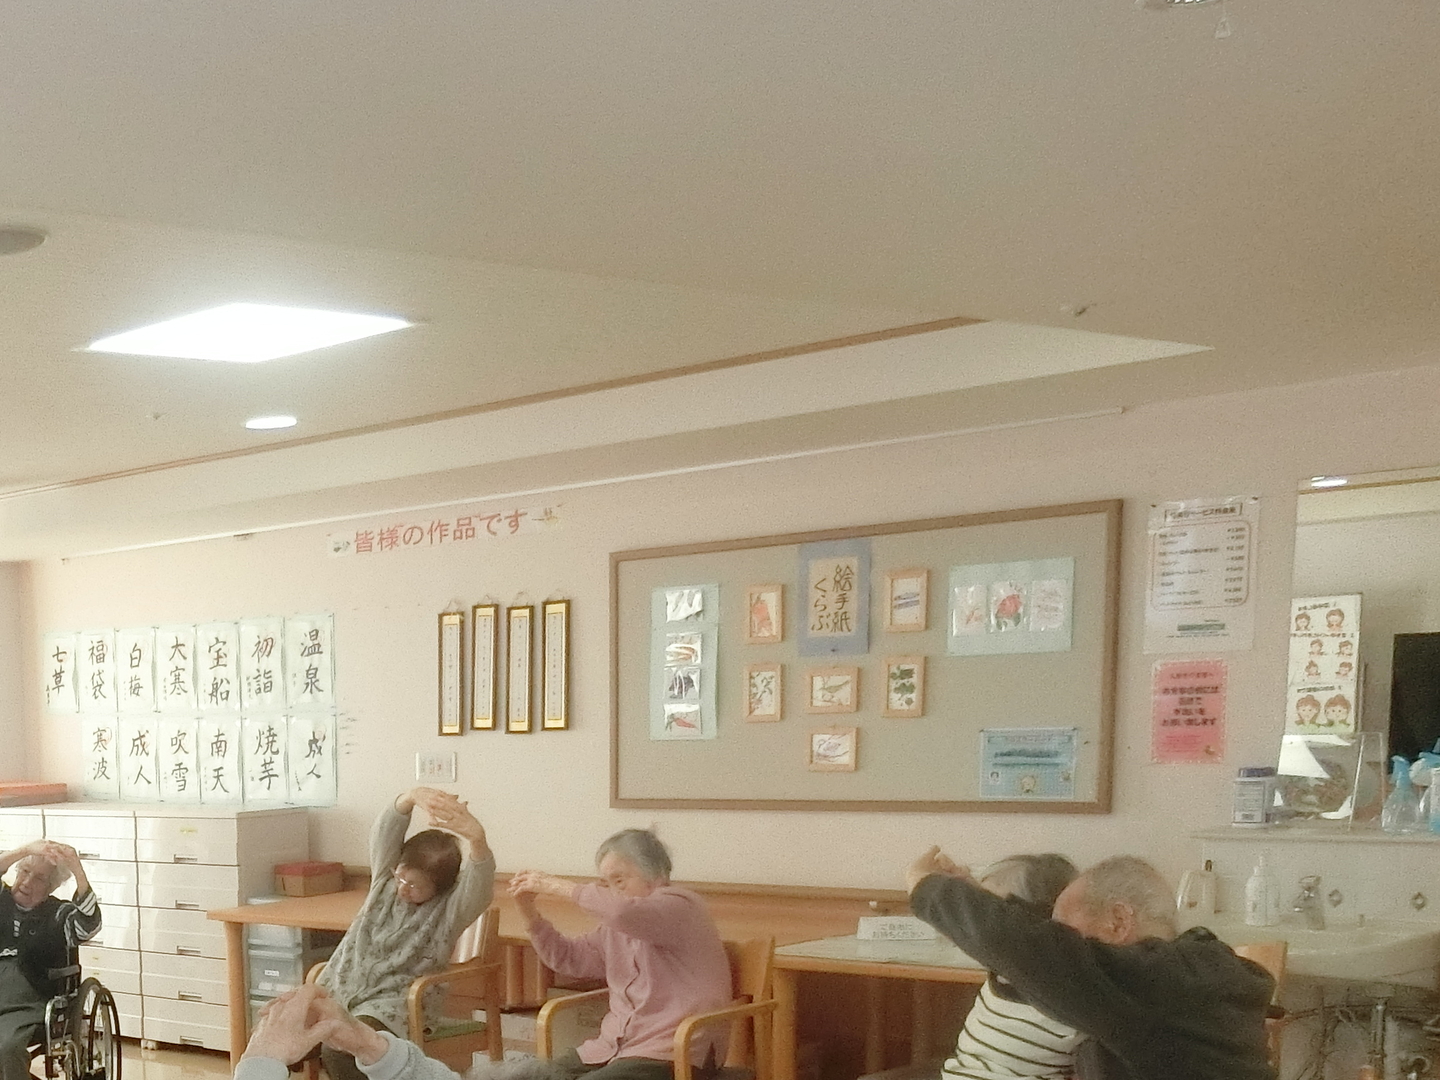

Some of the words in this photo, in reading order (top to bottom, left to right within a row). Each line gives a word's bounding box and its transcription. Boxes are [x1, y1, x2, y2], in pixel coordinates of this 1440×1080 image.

[354, 509, 528, 554] 皆様の作品です
[811, 577, 831, 632] くらぶ
[831, 564, 855, 633] 絵手紙
[52, 646, 67, 695] 七草
[88, 640, 107, 700] 福袋
[128, 643, 144, 697] 白梅
[169, 636, 188, 696] 大寒
[207, 637, 231, 706] 宝船
[251, 635, 274, 696] 初詣
[300, 628, 324, 695] 温泉
[92, 727, 111, 781] 寒波
[129, 730, 152, 785] 成人
[170, 730, 189, 792] 吹雪
[210, 729, 230, 793] 南天
[254, 725, 280, 790] 焼芋
